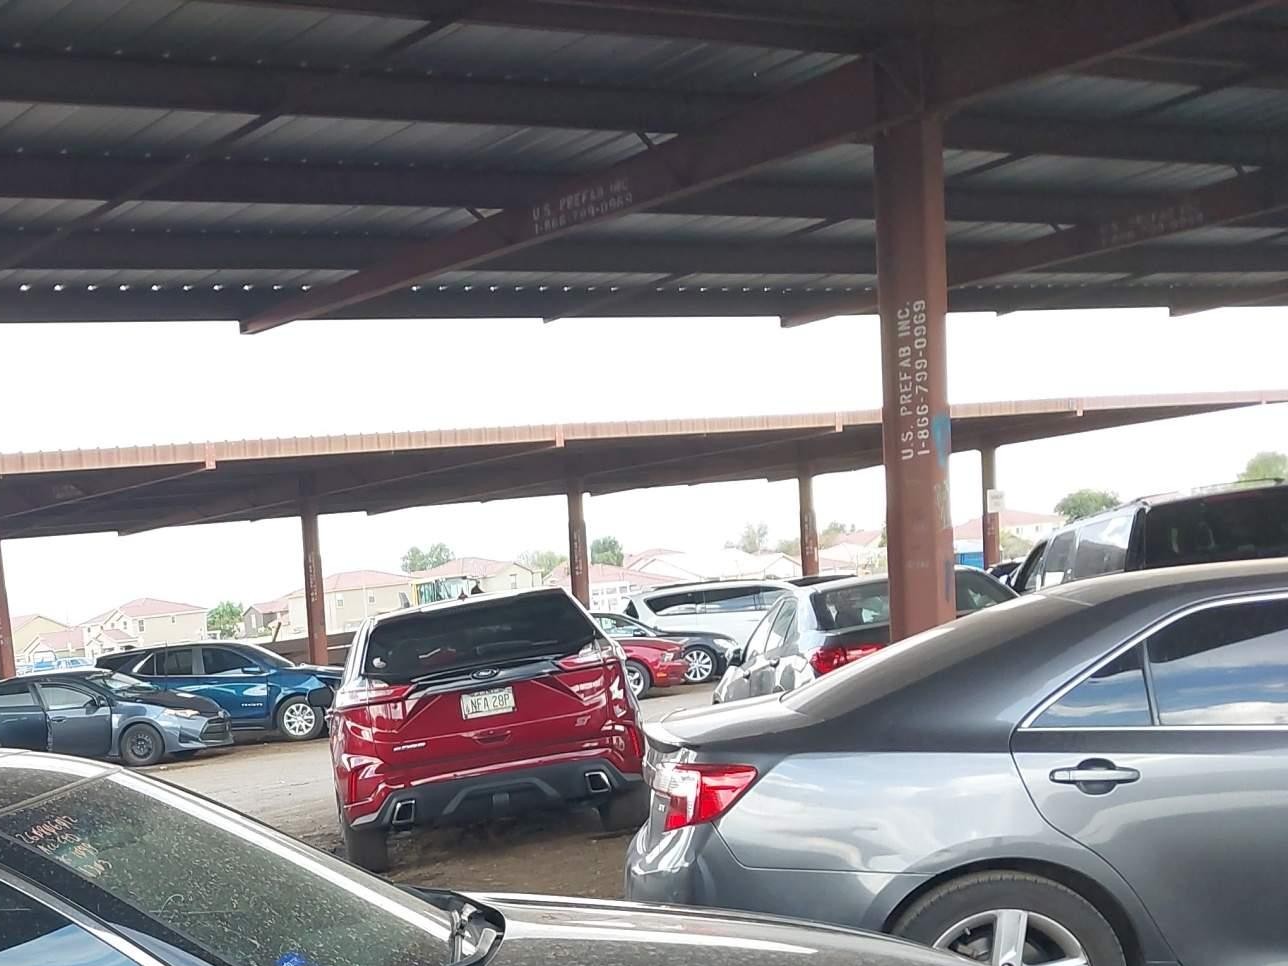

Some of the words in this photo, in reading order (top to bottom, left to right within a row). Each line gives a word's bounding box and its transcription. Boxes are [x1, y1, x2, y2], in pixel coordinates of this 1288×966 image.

[897, 301, 911, 338] INC.
[898, 345, 913, 417] PREFAB
[913, 299, 931, 457] 1-866-799-0969
[900, 424, 914, 461] U.S.
